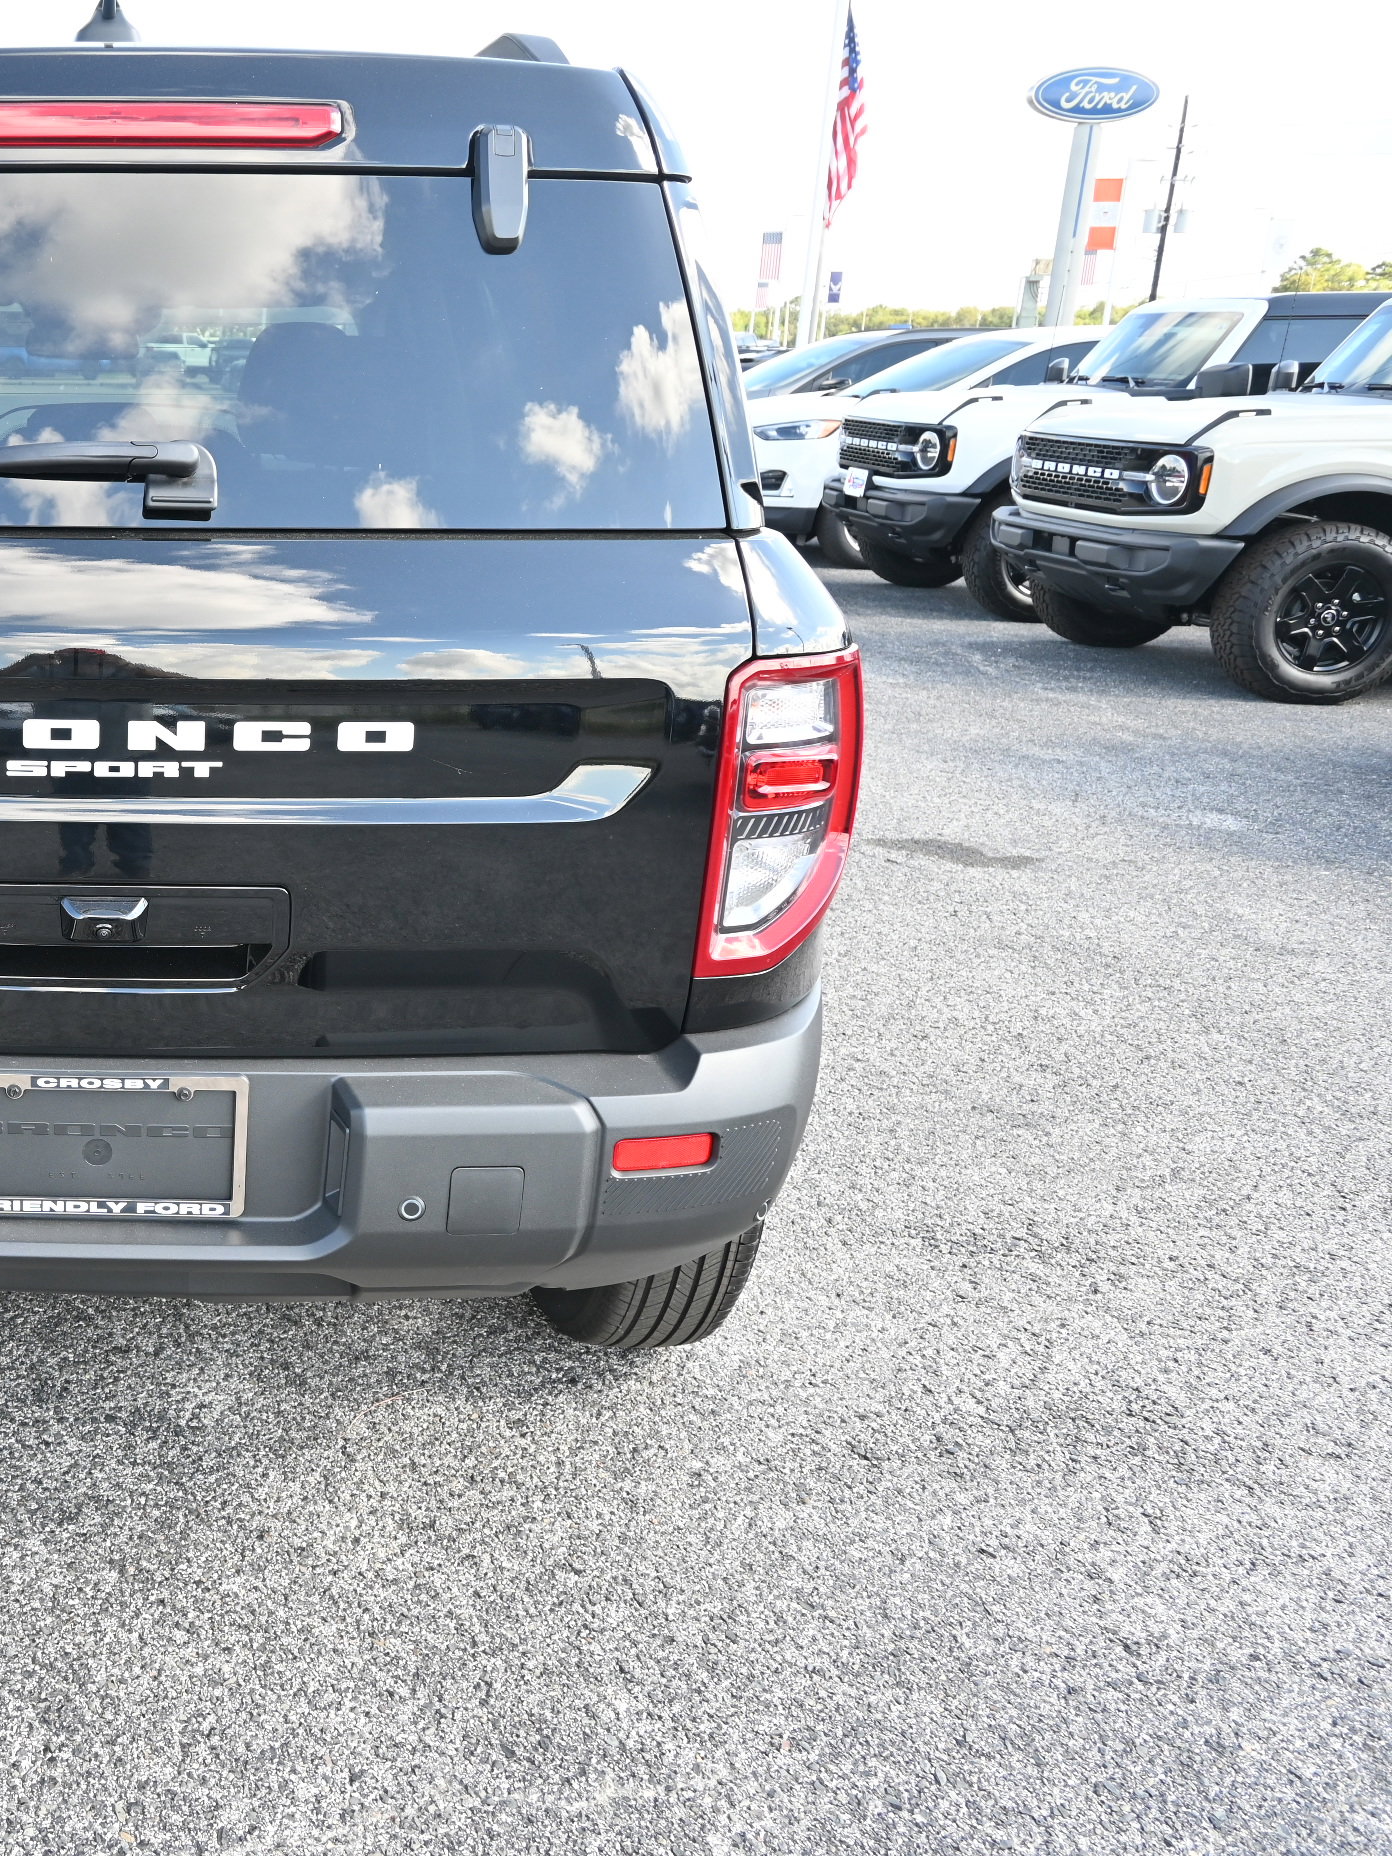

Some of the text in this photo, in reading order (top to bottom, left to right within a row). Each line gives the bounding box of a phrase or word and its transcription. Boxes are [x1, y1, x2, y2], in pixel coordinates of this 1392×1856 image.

[1060, 75, 1138, 109] Ford
[845, 436, 898, 451] BRONCO
[1031, 459, 1120, 480] BRONCO
[5, 760, 224, 779] SPORT
[35, 1076, 165, 1090] CROSBY
[136, 1202, 226, 1217] FORD
